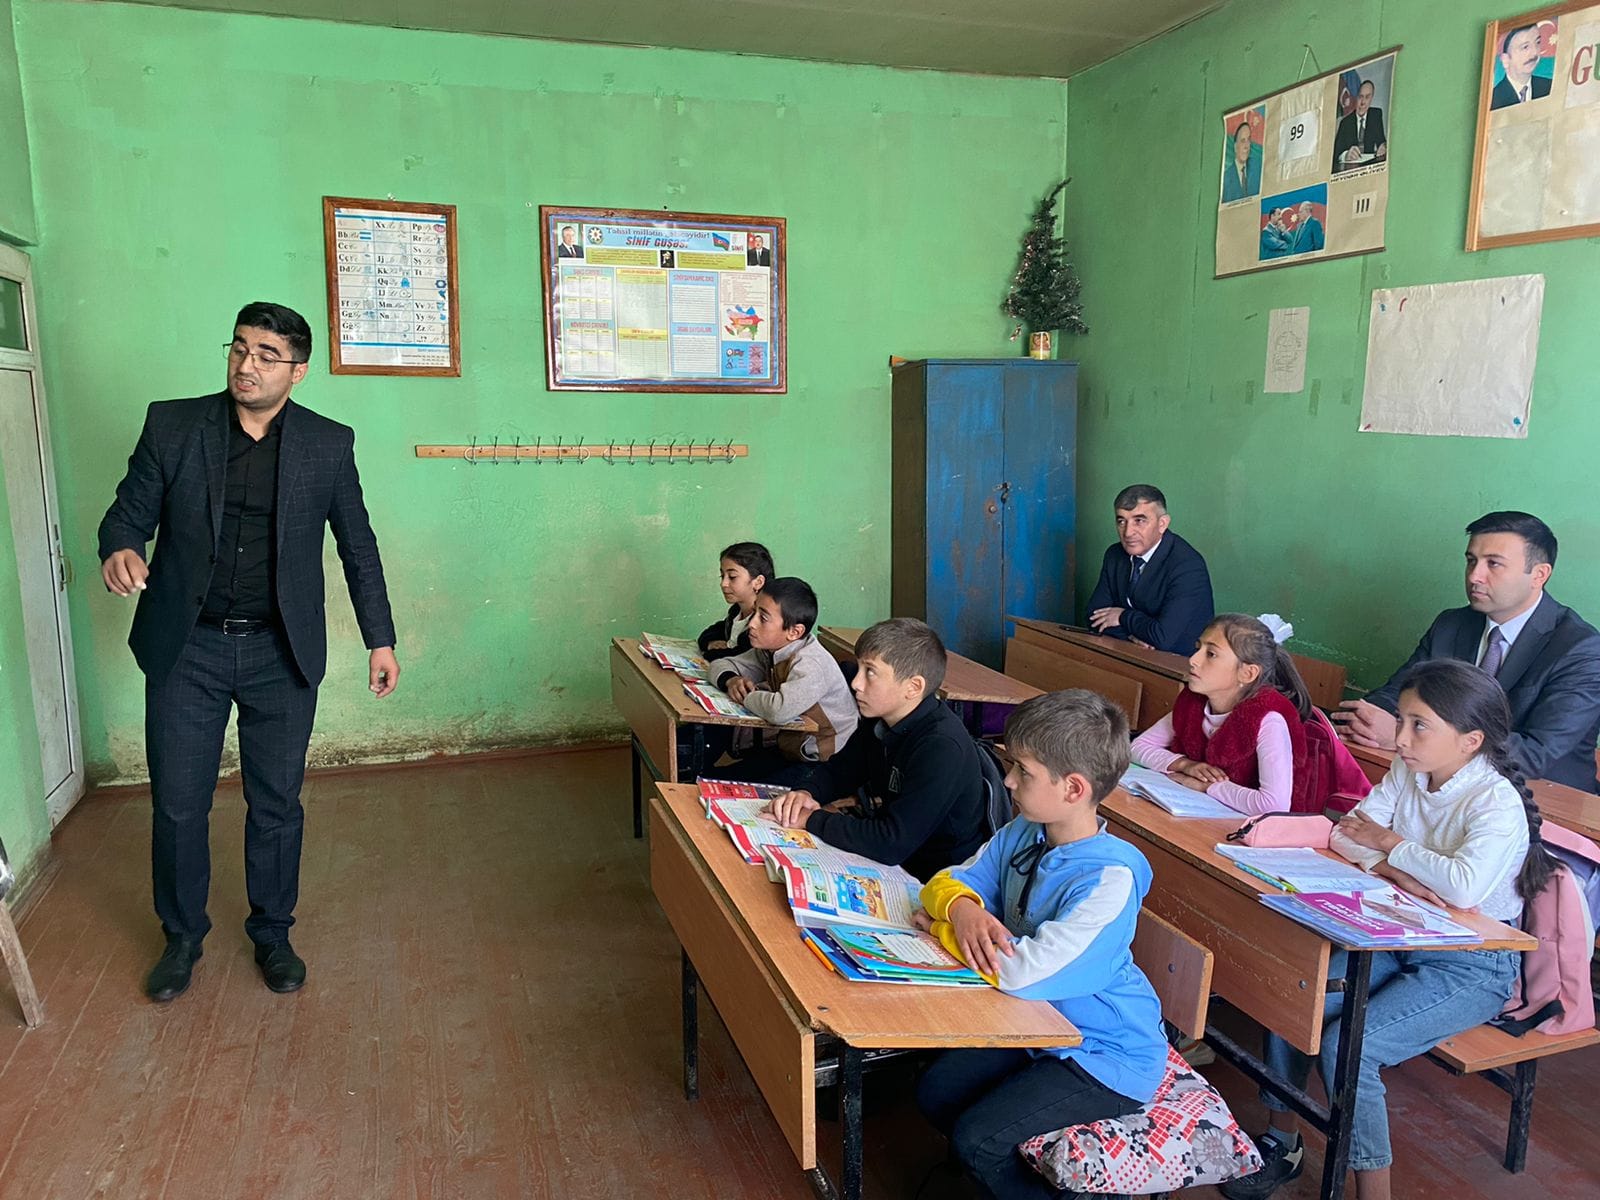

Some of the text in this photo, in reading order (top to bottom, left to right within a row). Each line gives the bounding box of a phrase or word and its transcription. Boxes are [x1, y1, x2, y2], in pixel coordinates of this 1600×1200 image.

[1290, 123, 1305, 141] 99
[412, 223, 422, 231] Pp
[625, 235, 651, 247] SİNİF
